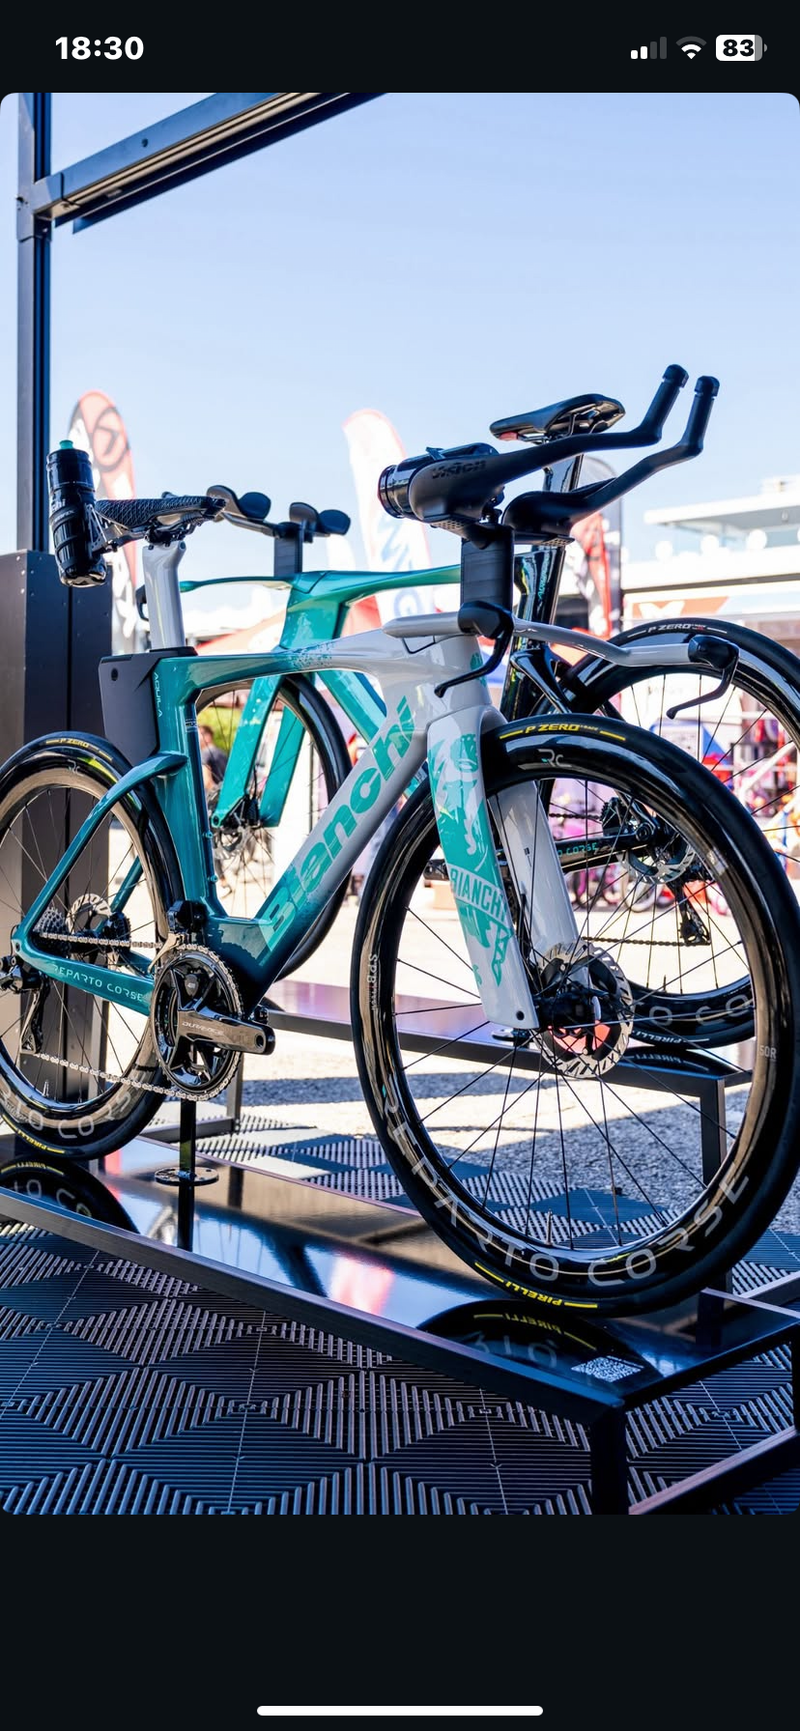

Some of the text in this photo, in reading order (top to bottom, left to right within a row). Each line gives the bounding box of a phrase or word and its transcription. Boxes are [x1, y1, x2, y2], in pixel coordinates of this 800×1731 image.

[658, 623, 691, 631] ZERO
[153, 672, 163, 718] AQUILA
[68, 738, 89, 748] ZERO
[525, 725, 536, 734] P
[538, 723, 581, 732] ZERO
[259, 696, 415, 951] Bianchi
[450, 867, 508, 922] BIANCHI
[54, 963, 144, 1002] REPARTO CORSE
[635, 1030, 682, 1044] PIRELLI
[382, 1073, 749, 1287] REPARTO CORSE
[505, 1281, 562, 1306] PIRELLI
